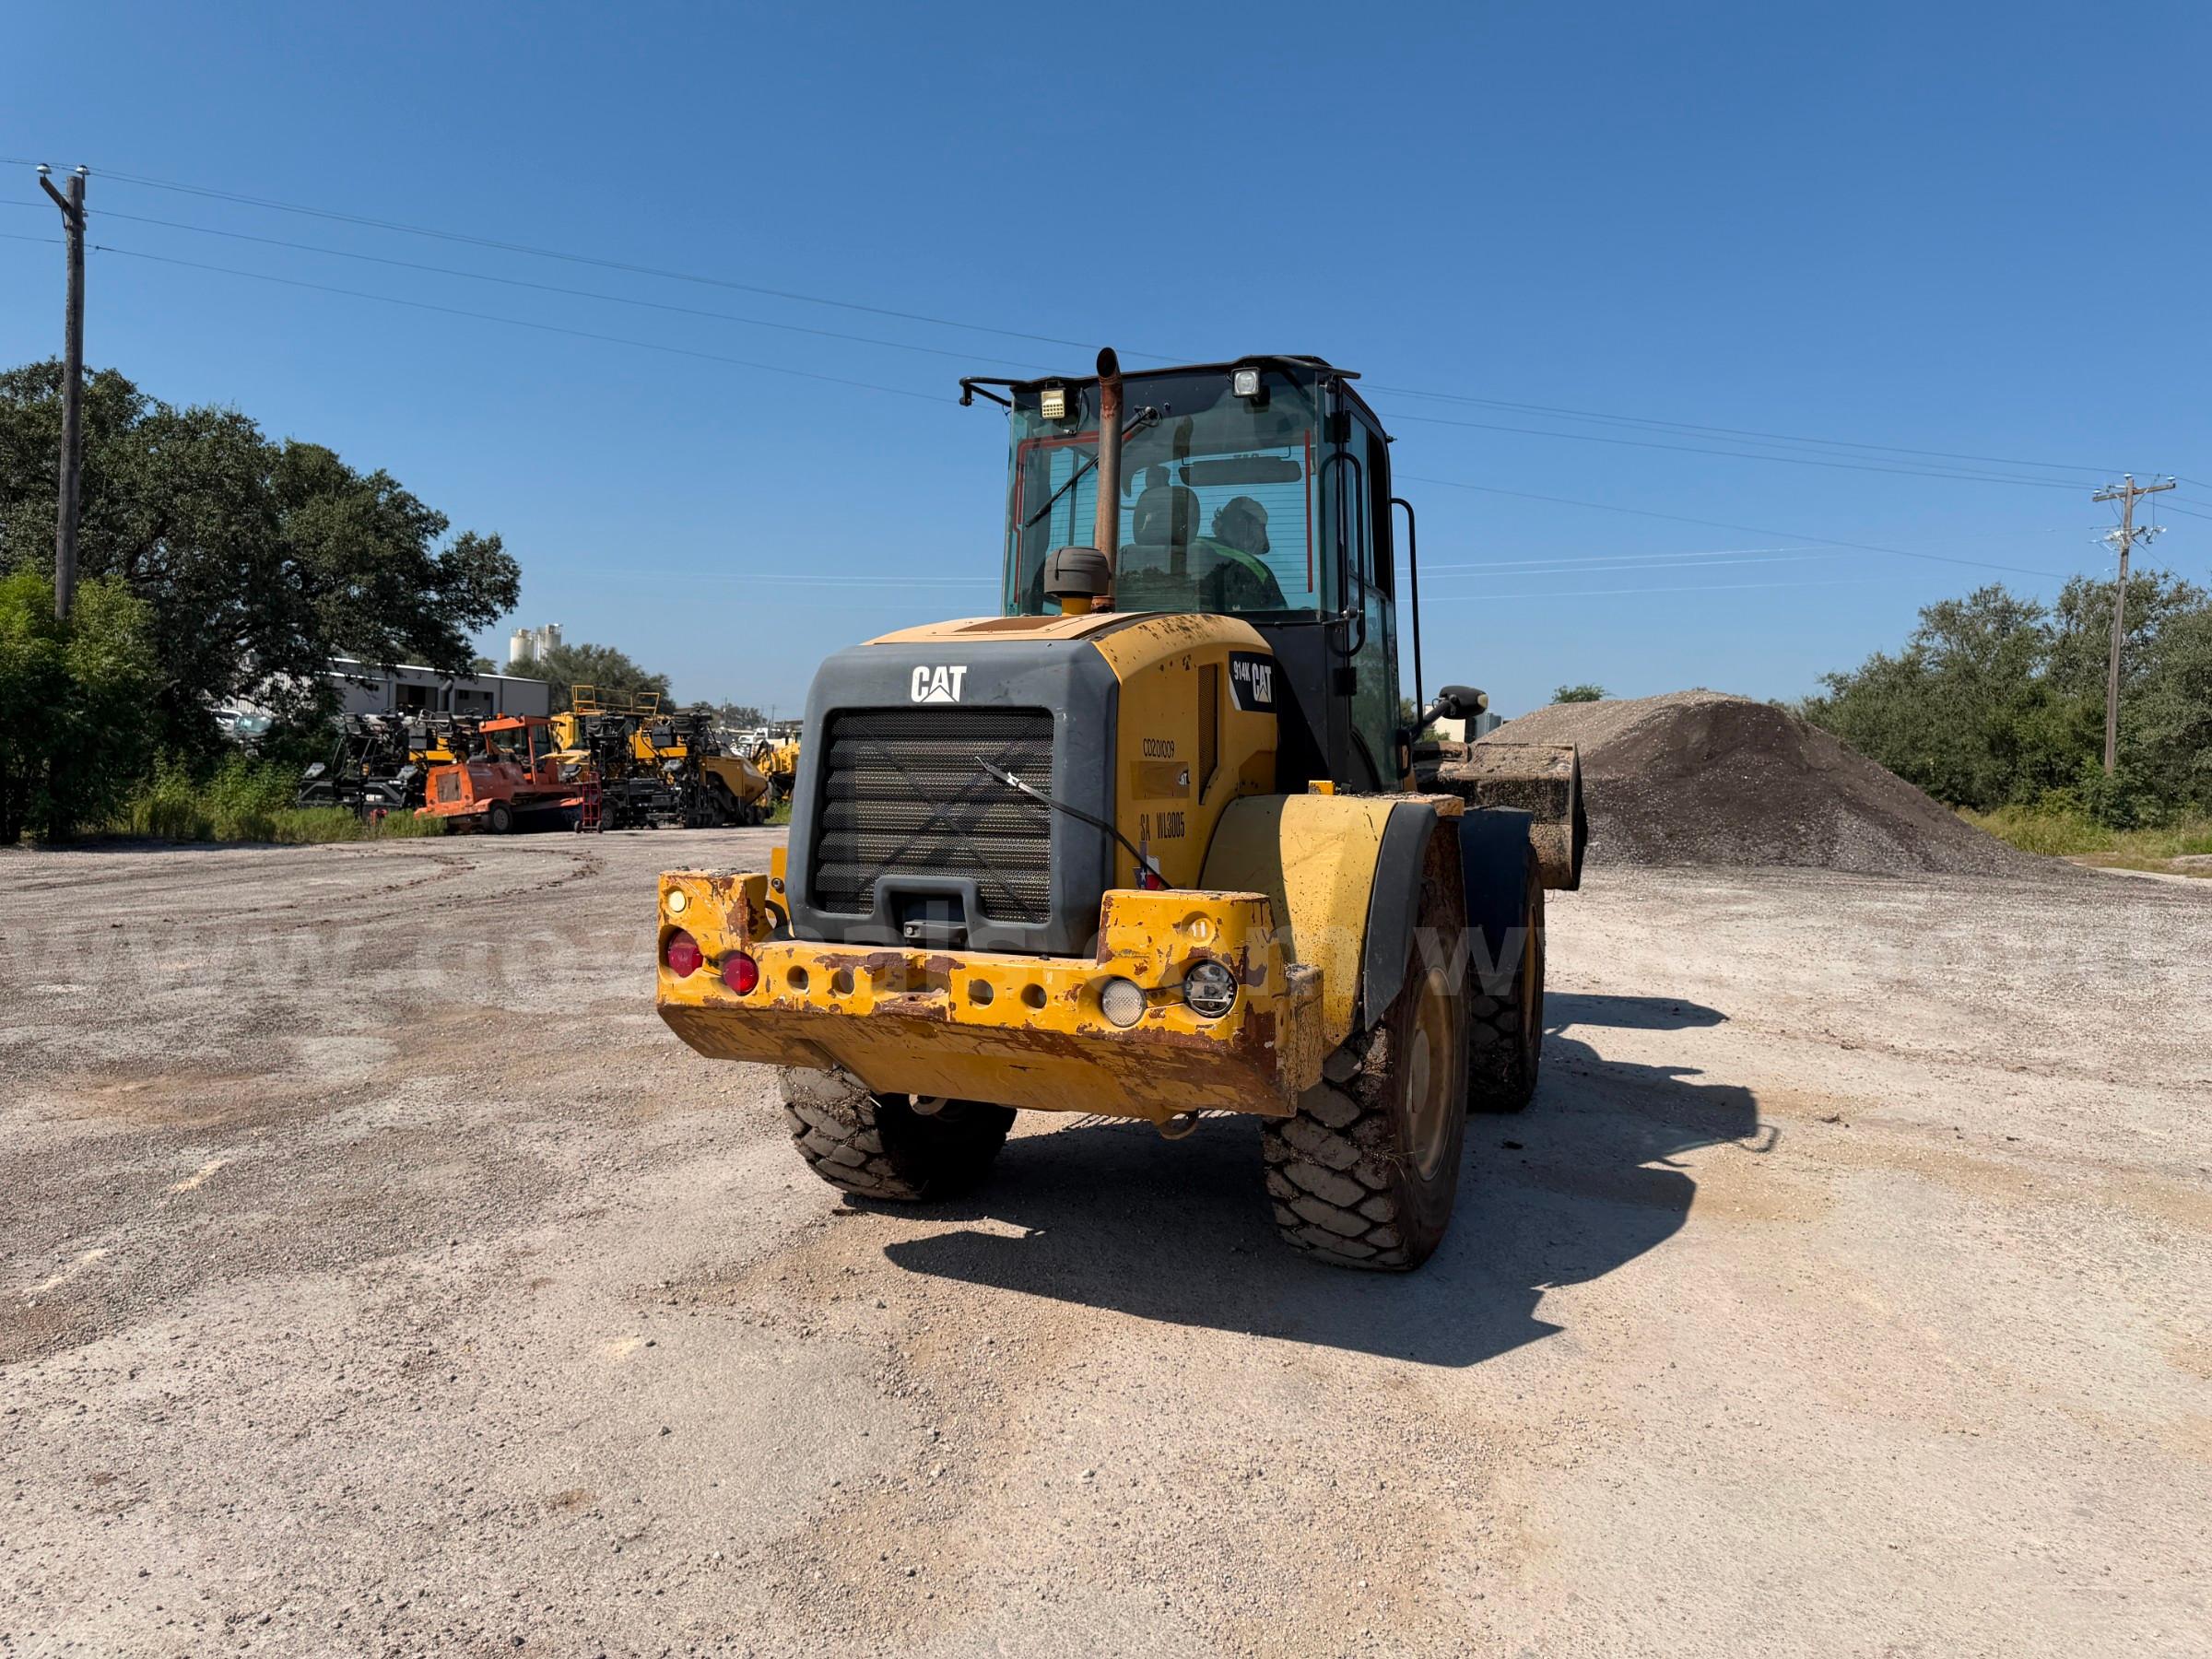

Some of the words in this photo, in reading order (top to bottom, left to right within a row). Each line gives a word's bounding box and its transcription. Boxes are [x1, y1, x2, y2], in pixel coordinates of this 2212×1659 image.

[911, 665, 968, 703] CAT
[1233, 660, 1251, 682] 914K
[1252, 663, 1272, 703] CAT
